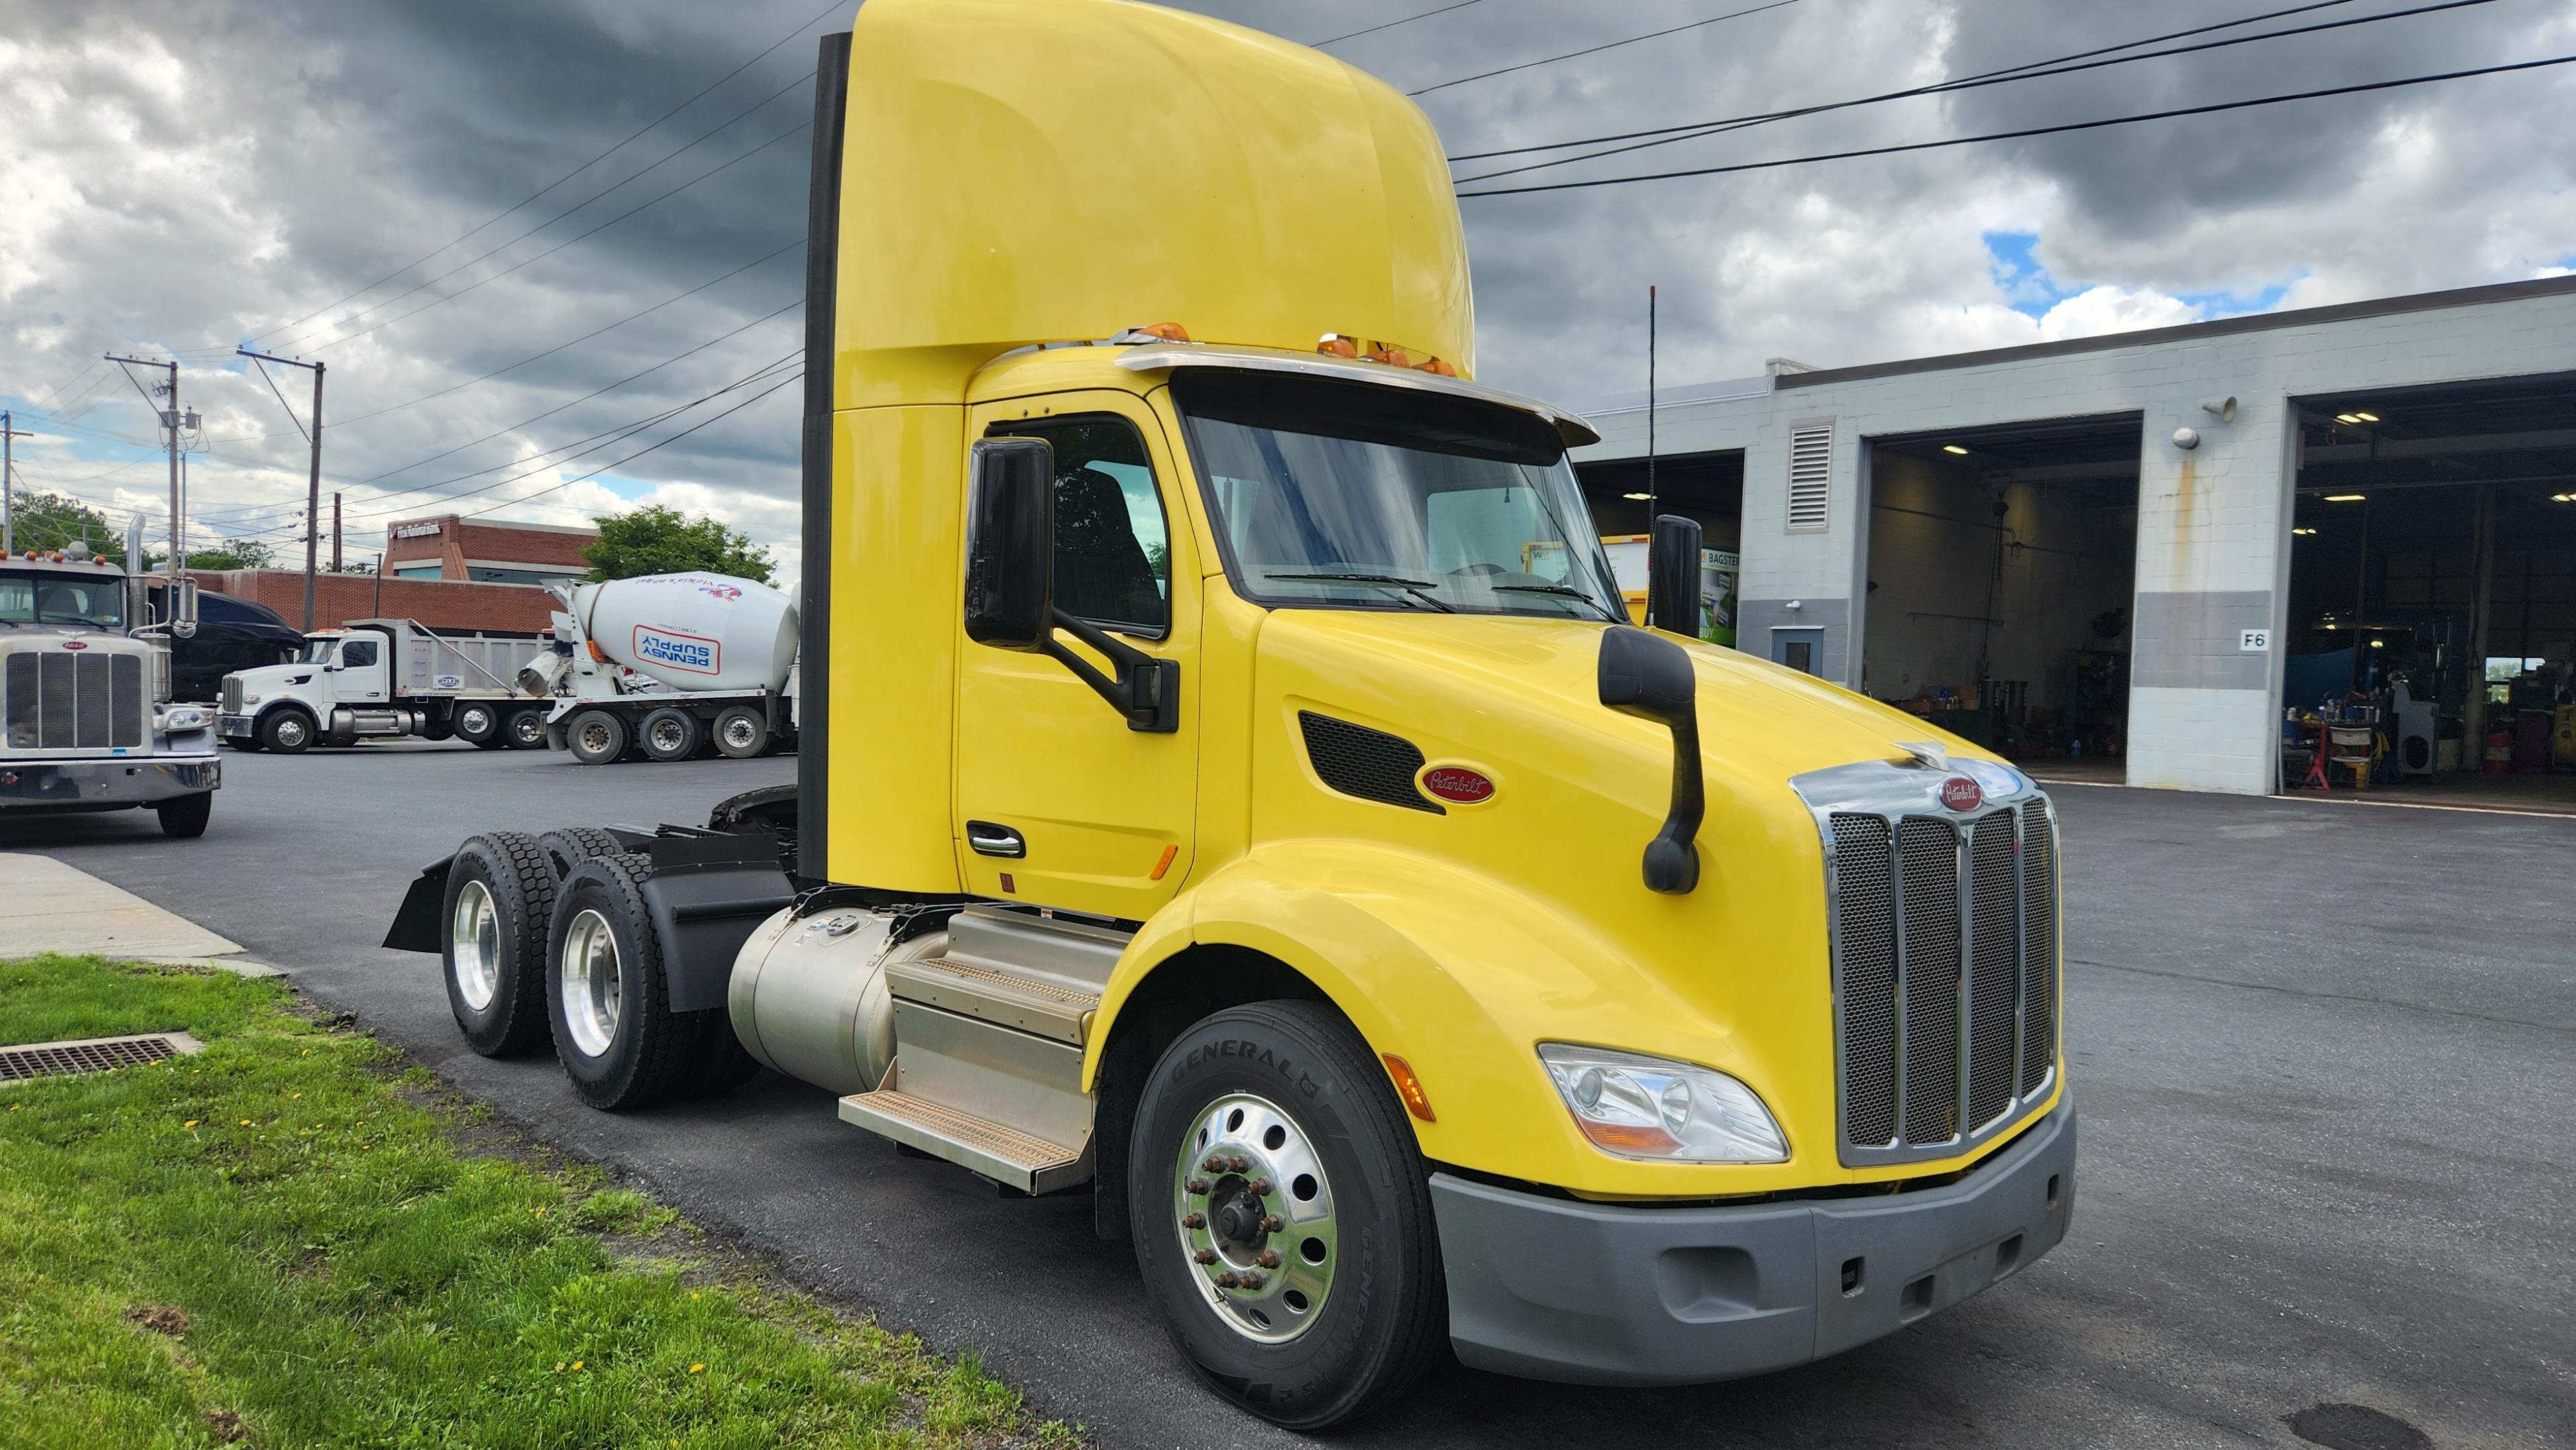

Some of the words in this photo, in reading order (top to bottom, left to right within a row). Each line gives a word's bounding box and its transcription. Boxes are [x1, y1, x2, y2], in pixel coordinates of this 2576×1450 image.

[642, 635, 710, 657] SUPPLY
[2245, 633, 2265, 647] F6
[643, 646, 709, 666] PENNSY
[1430, 771, 1488, 794] Peterbilt
[1945, 783, 1977, 802] Peterbilt
[1171, 1040, 1294, 1084] GENERAL
